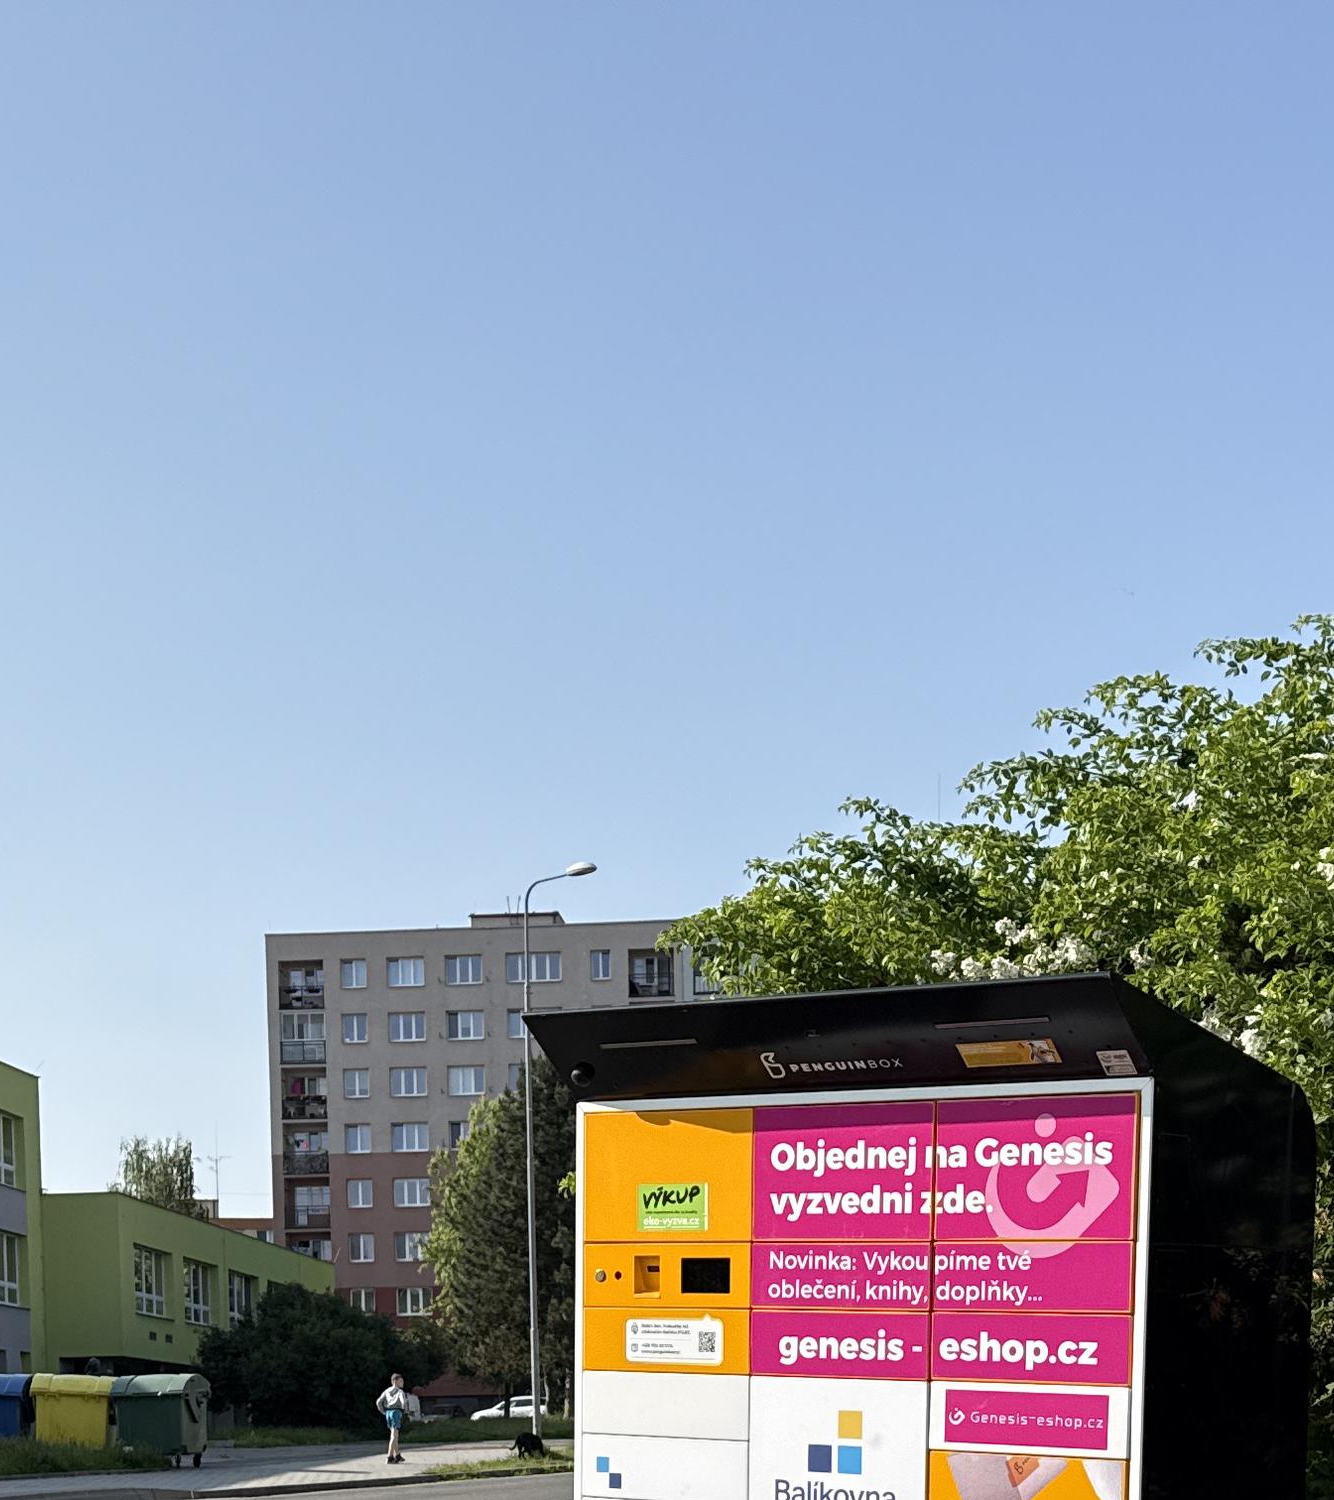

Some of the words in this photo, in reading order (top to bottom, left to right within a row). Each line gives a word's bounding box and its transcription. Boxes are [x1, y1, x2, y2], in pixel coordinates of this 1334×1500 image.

[789, 1058, 904, 1073] PENGUINBOX
[770, 1136, 917, 1178] Objednej
[924, 1143, 968, 1169] na
[974, 1131, 1114, 1168] Genesis
[643, 1185, 701, 1210] VÝKUP
[769, 1182, 914, 1222] vyzvedni
[919, 1183, 994, 1214] zde.
[769, 1250, 857, 1271] Novinka:
[997, 1249, 1032, 1271] tvé
[768, 1278, 861, 1303] oblečení,
[865, 1280, 929, 1305] knihy,
[935, 1280, 1043, 1306] doplňky...
[778, 1328, 904, 1366] genesis
[939, 1331, 1099, 1371] eshop.cz
[970, 1411, 1104, 1430] Genesis-eshop.cz
